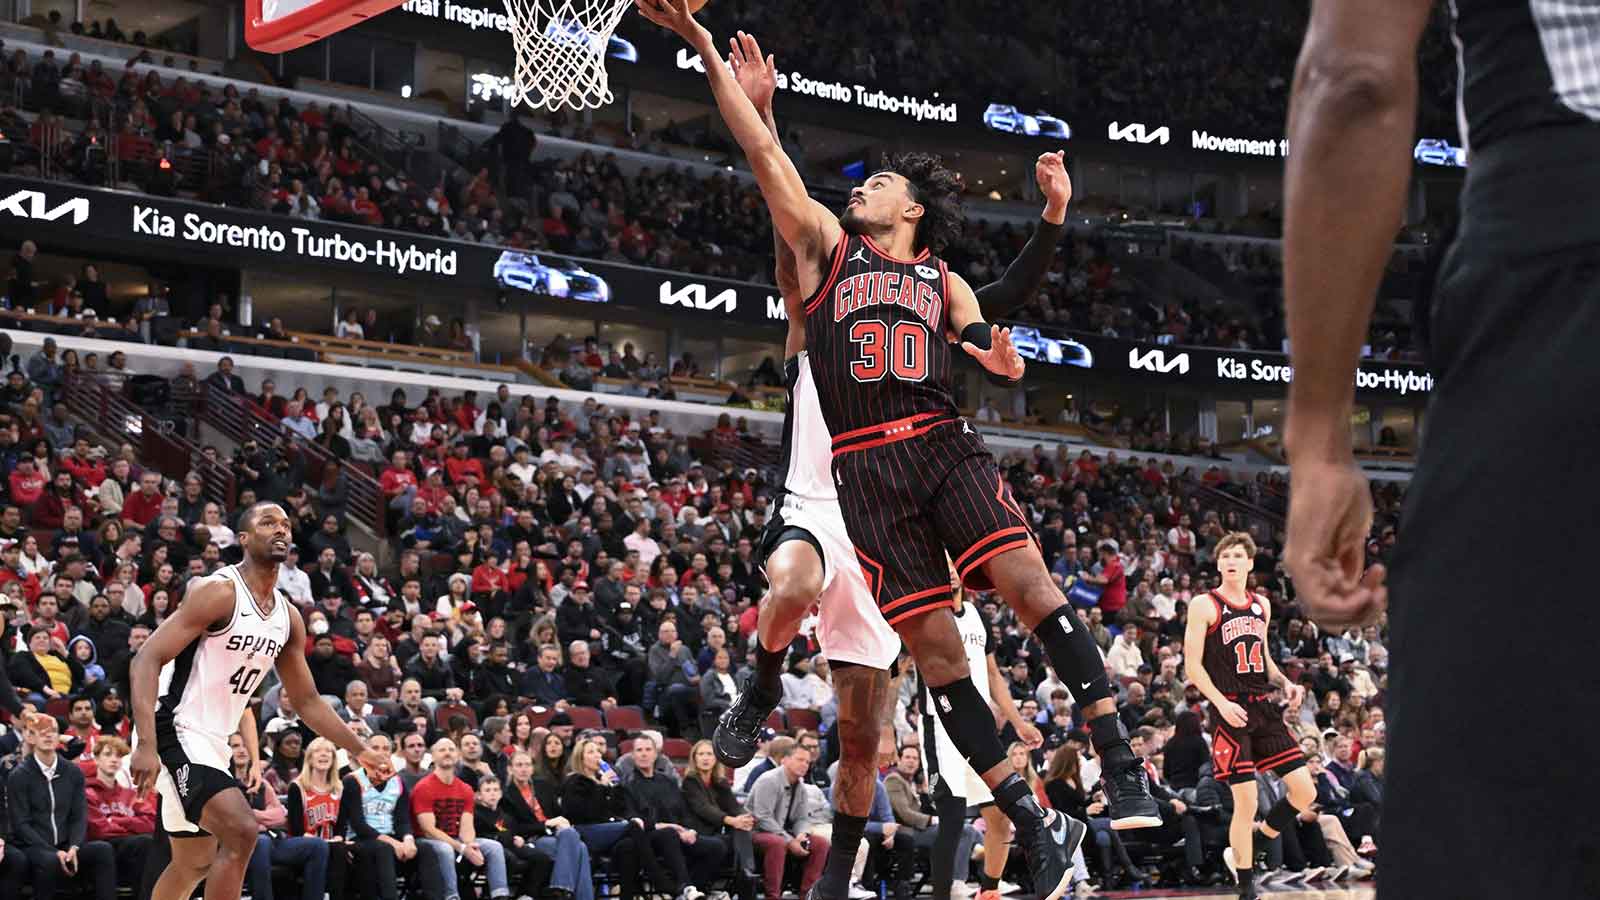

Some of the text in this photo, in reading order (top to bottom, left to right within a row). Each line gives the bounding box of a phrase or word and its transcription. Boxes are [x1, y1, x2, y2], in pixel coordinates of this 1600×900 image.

[791, 72, 852, 102] Sorento
[854, 85, 957, 122] Turbo-Hybrid
[1108, 121, 1170, 144] KIA
[1192, 130, 1277, 156] Movement
[133, 206, 457, 275] Kia Sorento Turbo-Hybrid
[659, 281, 737, 312] KIA
[834, 272, 942, 332] CHICAGO
[850, 319, 929, 382] 30
[1129, 347, 1190, 374] KIA
[1217, 357, 1294, 382] Kia Sore
[1356, 367, 1433, 395] bo-Hybri
[1234, 641, 1264, 673] 14
[229, 665, 261, 694] 40
